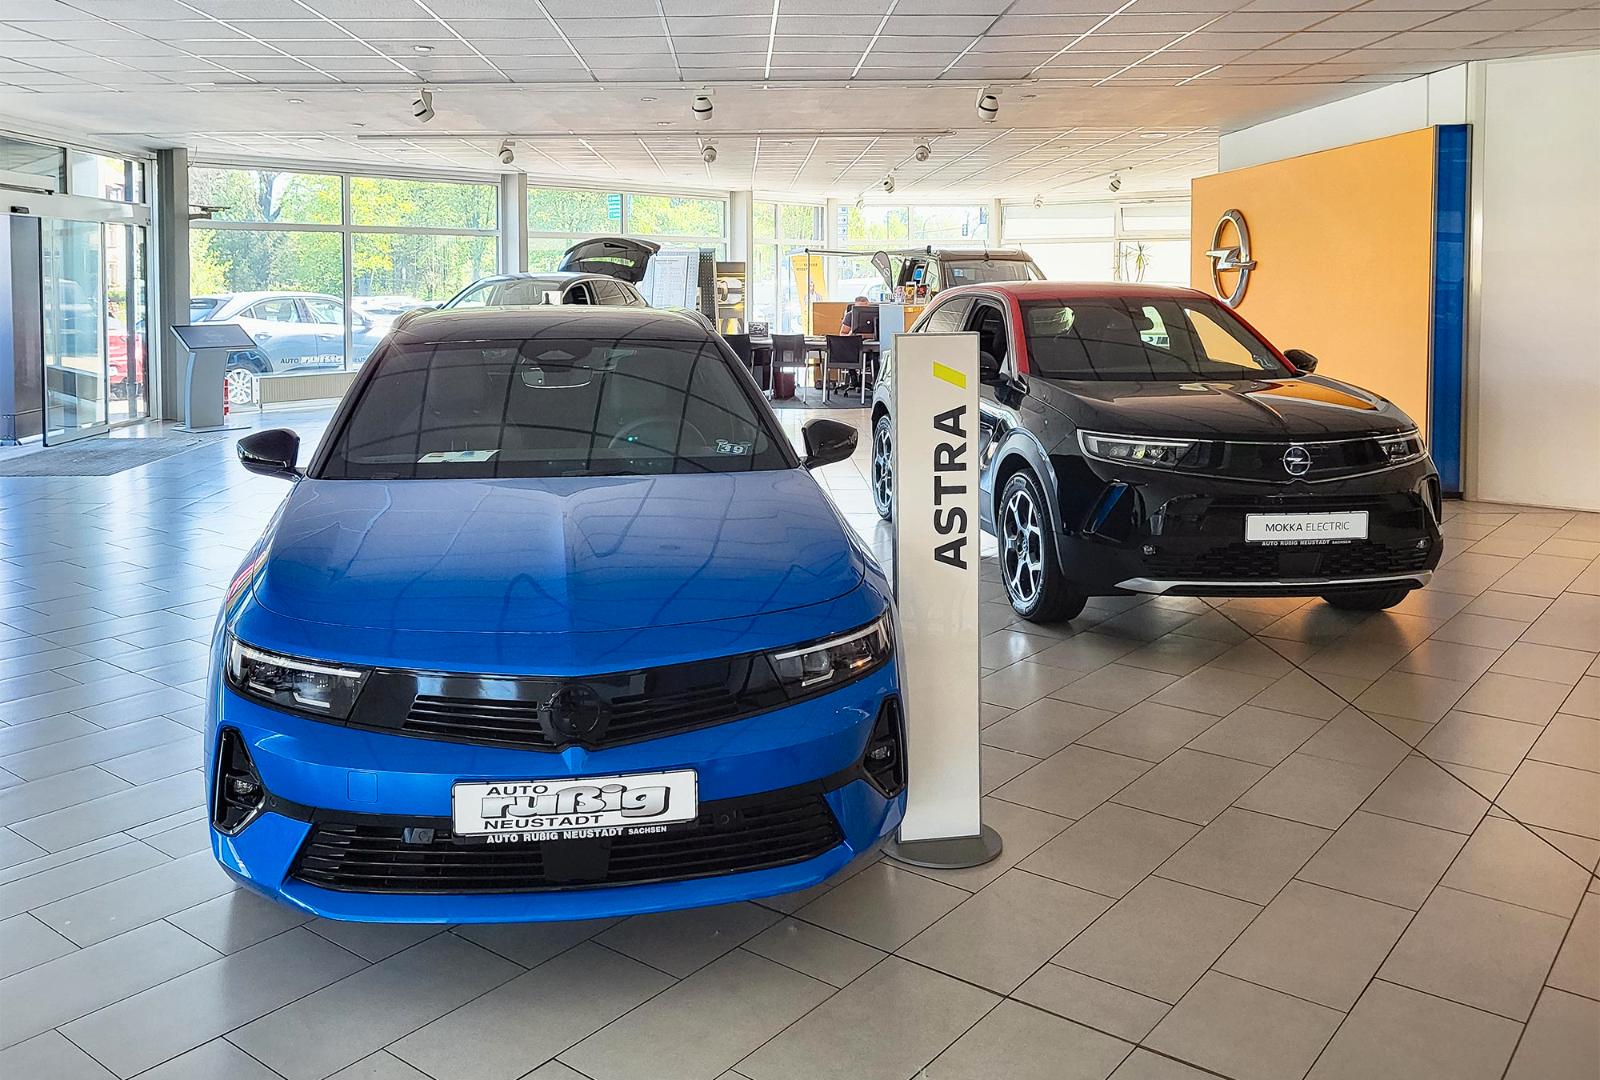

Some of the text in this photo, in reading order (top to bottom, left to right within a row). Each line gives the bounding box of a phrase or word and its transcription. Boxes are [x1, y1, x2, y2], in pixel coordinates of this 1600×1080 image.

[933, 405, 968, 570] ASTRA
[1265, 521, 1350, 532] MOKKA ELECTRIC
[486, 784, 549, 796] AUTO
[484, 815, 604, 830] NEUSTADT
[487, 833, 518, 844] AUTO
[563, 827, 624, 840] NEUSTADT
[628, 825, 667, 835] SACHSEN
